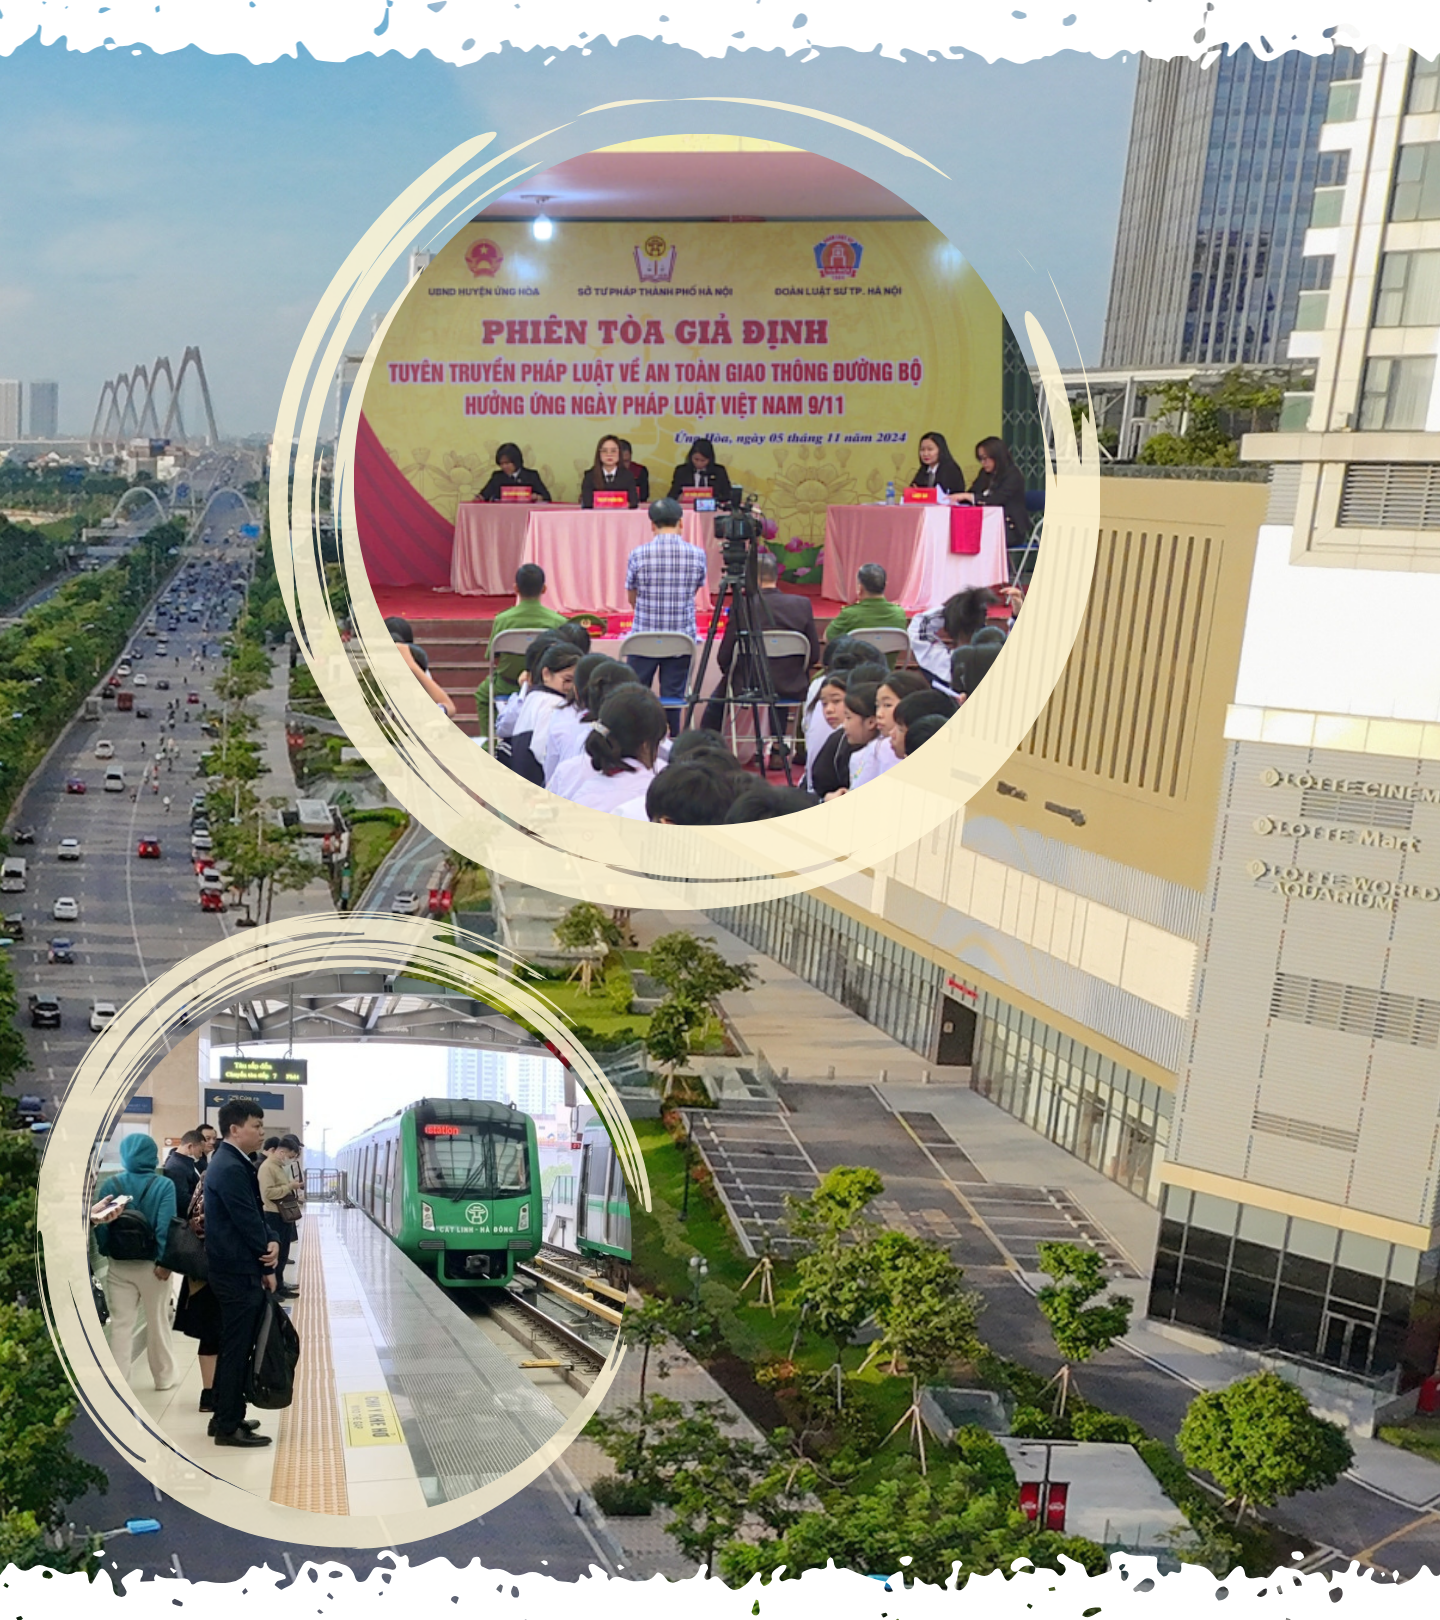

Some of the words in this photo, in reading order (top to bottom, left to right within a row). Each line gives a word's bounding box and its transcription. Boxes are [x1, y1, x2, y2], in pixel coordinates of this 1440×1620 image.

[428, 288, 456, 296] UBND
[458, 287, 492, 298] HUYỆN
[518, 286, 540, 296] HÒA
[578, 286, 592, 296] SỞ
[594, 287, 609, 296] TƯ
[610, 286, 636, 296] PHÁP
[639, 286, 674, 296] THÀNH
[675, 284, 697, 296] PHỐ
[698, 286, 713, 296] HÀ
[715, 286, 733, 298] NỘI
[774, 285, 804, 296] ĐOÀN
[805, 285, 830, 298] LUẬT
[833, 286, 849, 296] SƯ
[867, 285, 882, 296] HÀ
[883, 285, 902, 297] NỘI
[482, 314, 588, 345] PHIÊN
[598, 314, 665, 345] TÒA
[675, 312, 733, 345] GIẢ
[742, 318, 829, 350] ĐỊNH
[388, 359, 444, 383] TUYÊN
[449, 356, 516, 383] TRUYỀN
[521, 359, 567, 383] PHÁP
[573, 359, 614, 387] LUẬT
[619, 357, 640, 383] VỀ
[645, 363, 669, 383] AN
[675, 359, 720, 383] TOÀN
[726, 362, 766, 382] GIAO
[771, 358, 828, 382] THÔNG
[833, 358, 892, 382] ĐƯỜNG
[899, 358, 922, 386] BỘ
[465, 389, 524, 415] HƯỞNG
[530, 391, 565, 415] ỨNG
[571, 391, 617, 415] NGÀY
[623, 391, 669, 415] PHÁP
[675, 391, 715, 419] LUẬT
[721, 391, 757, 419] VIỆT
[763, 395, 803, 415] NAM
[808, 395, 844, 415] 9/11
[736, 432, 766, 445] ngày
[769, 433, 784, 443] 05
[787, 432, 823, 445] tháng
[844, 432, 872, 443] năm
[876, 433, 907, 443] 2024
[1359, 830, 1422, 852] Mart
[1273, 881, 1398, 913] AQUARIUM
